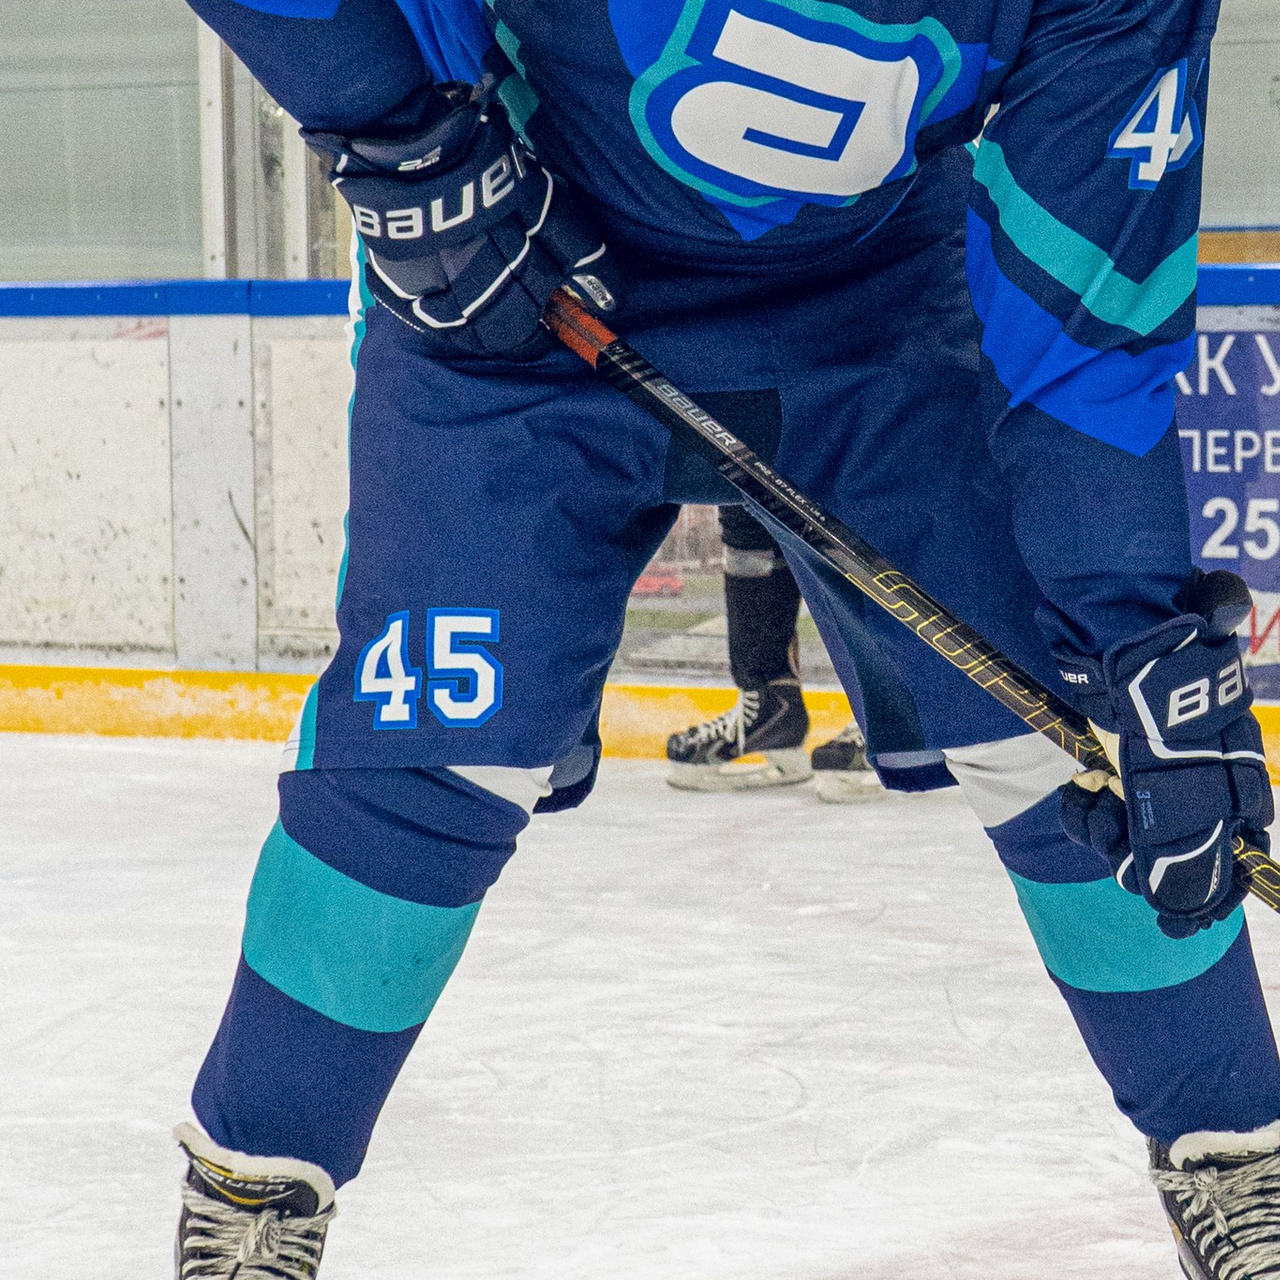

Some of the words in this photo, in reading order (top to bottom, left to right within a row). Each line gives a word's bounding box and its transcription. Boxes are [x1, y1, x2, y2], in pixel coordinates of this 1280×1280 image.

[1107, 61, 1200, 186] 4
[658, 383, 738, 448] BAUER
[355, 609, 501, 727] 45
